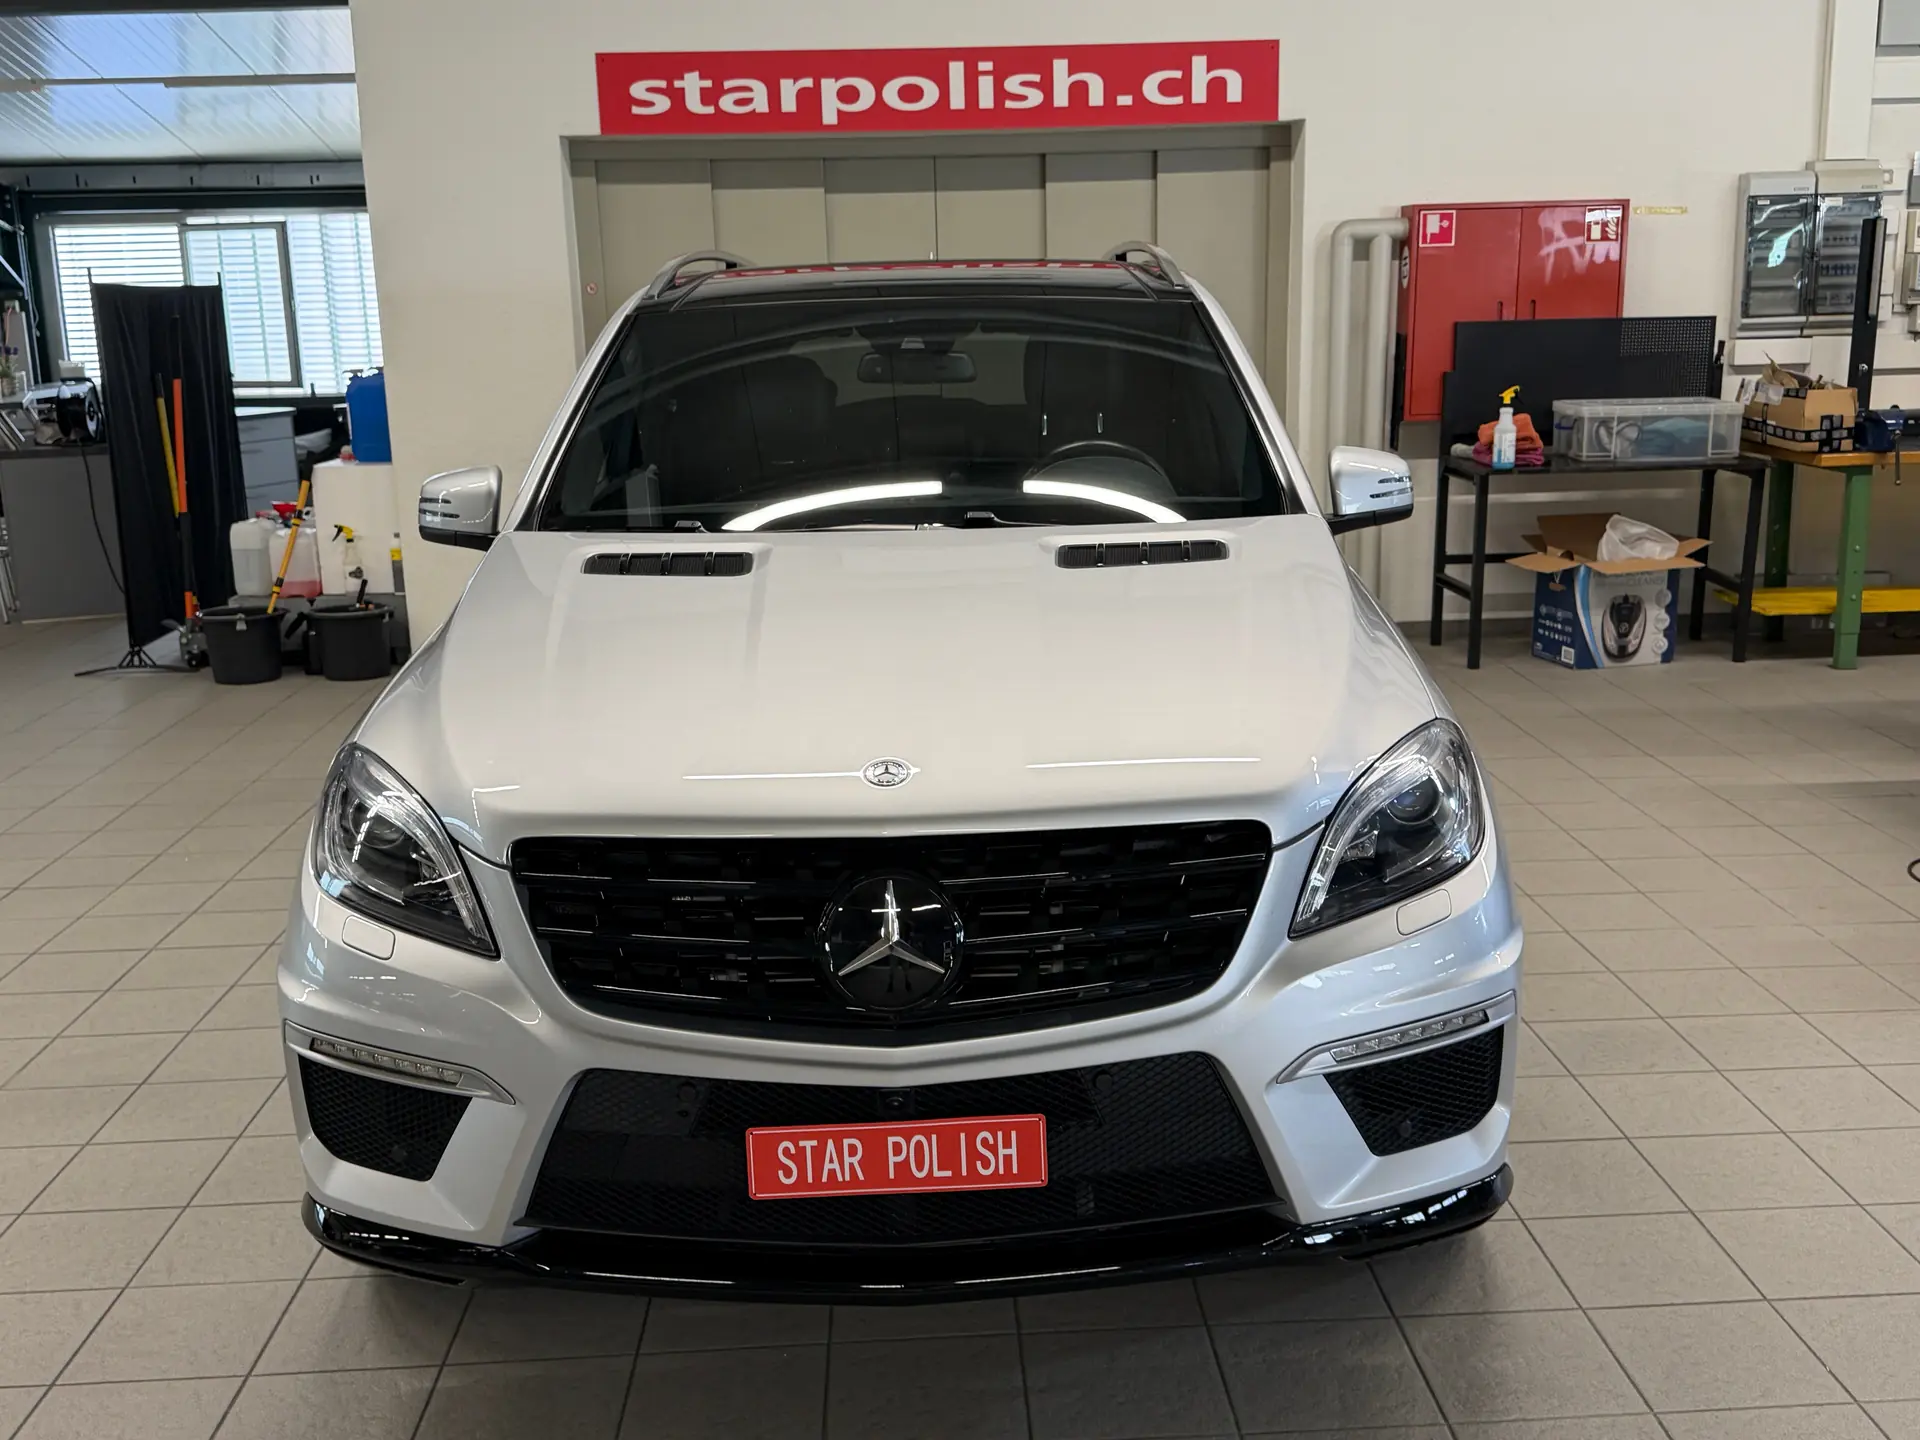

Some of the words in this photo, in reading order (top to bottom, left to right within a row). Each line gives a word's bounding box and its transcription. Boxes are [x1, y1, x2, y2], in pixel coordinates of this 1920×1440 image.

[629, 55, 1243, 125] starpolish.ch
[777, 1138, 865, 1185] STAR
[887, 1130, 1018, 1179] POLISH
